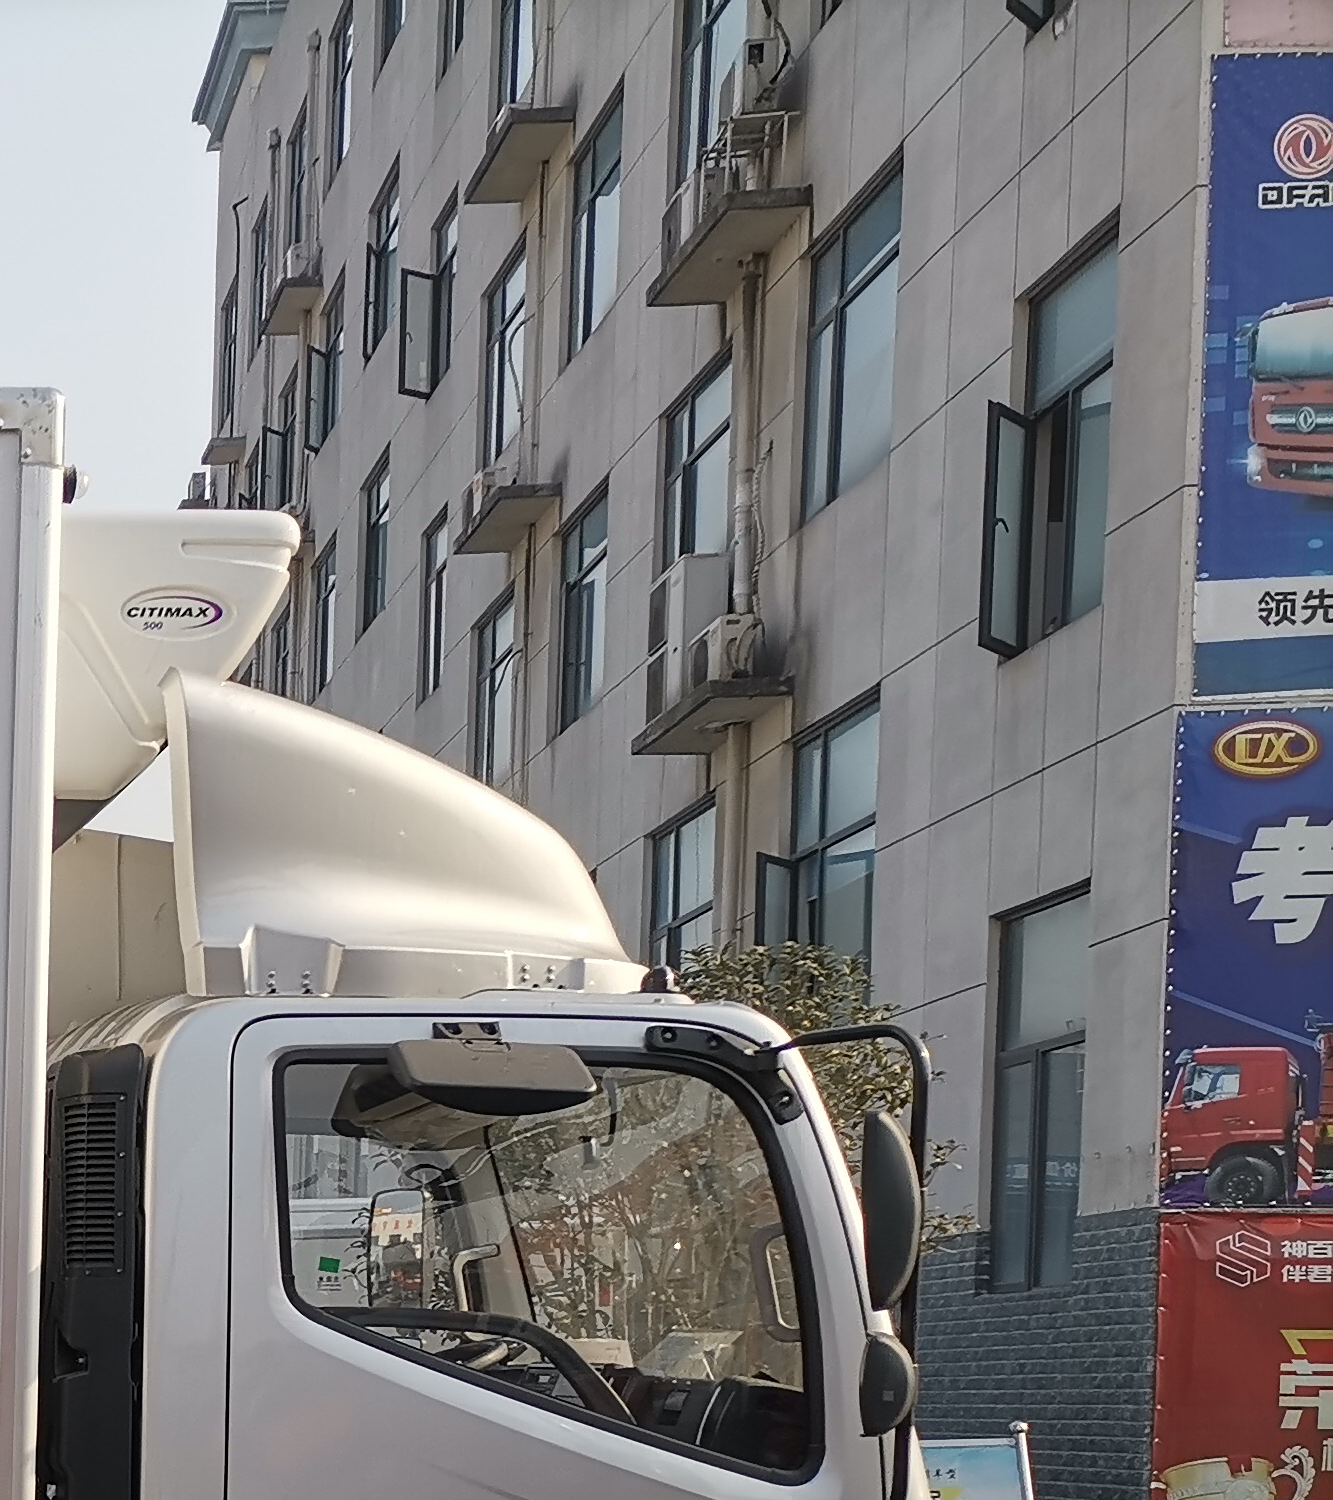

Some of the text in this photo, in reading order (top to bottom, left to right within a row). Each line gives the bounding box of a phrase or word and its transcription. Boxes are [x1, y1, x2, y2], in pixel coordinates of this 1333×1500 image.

[127, 607, 210, 618] CITIMAX
[1258, 588, 1333, 627] 领先
[142, 621, 164, 631] 500
